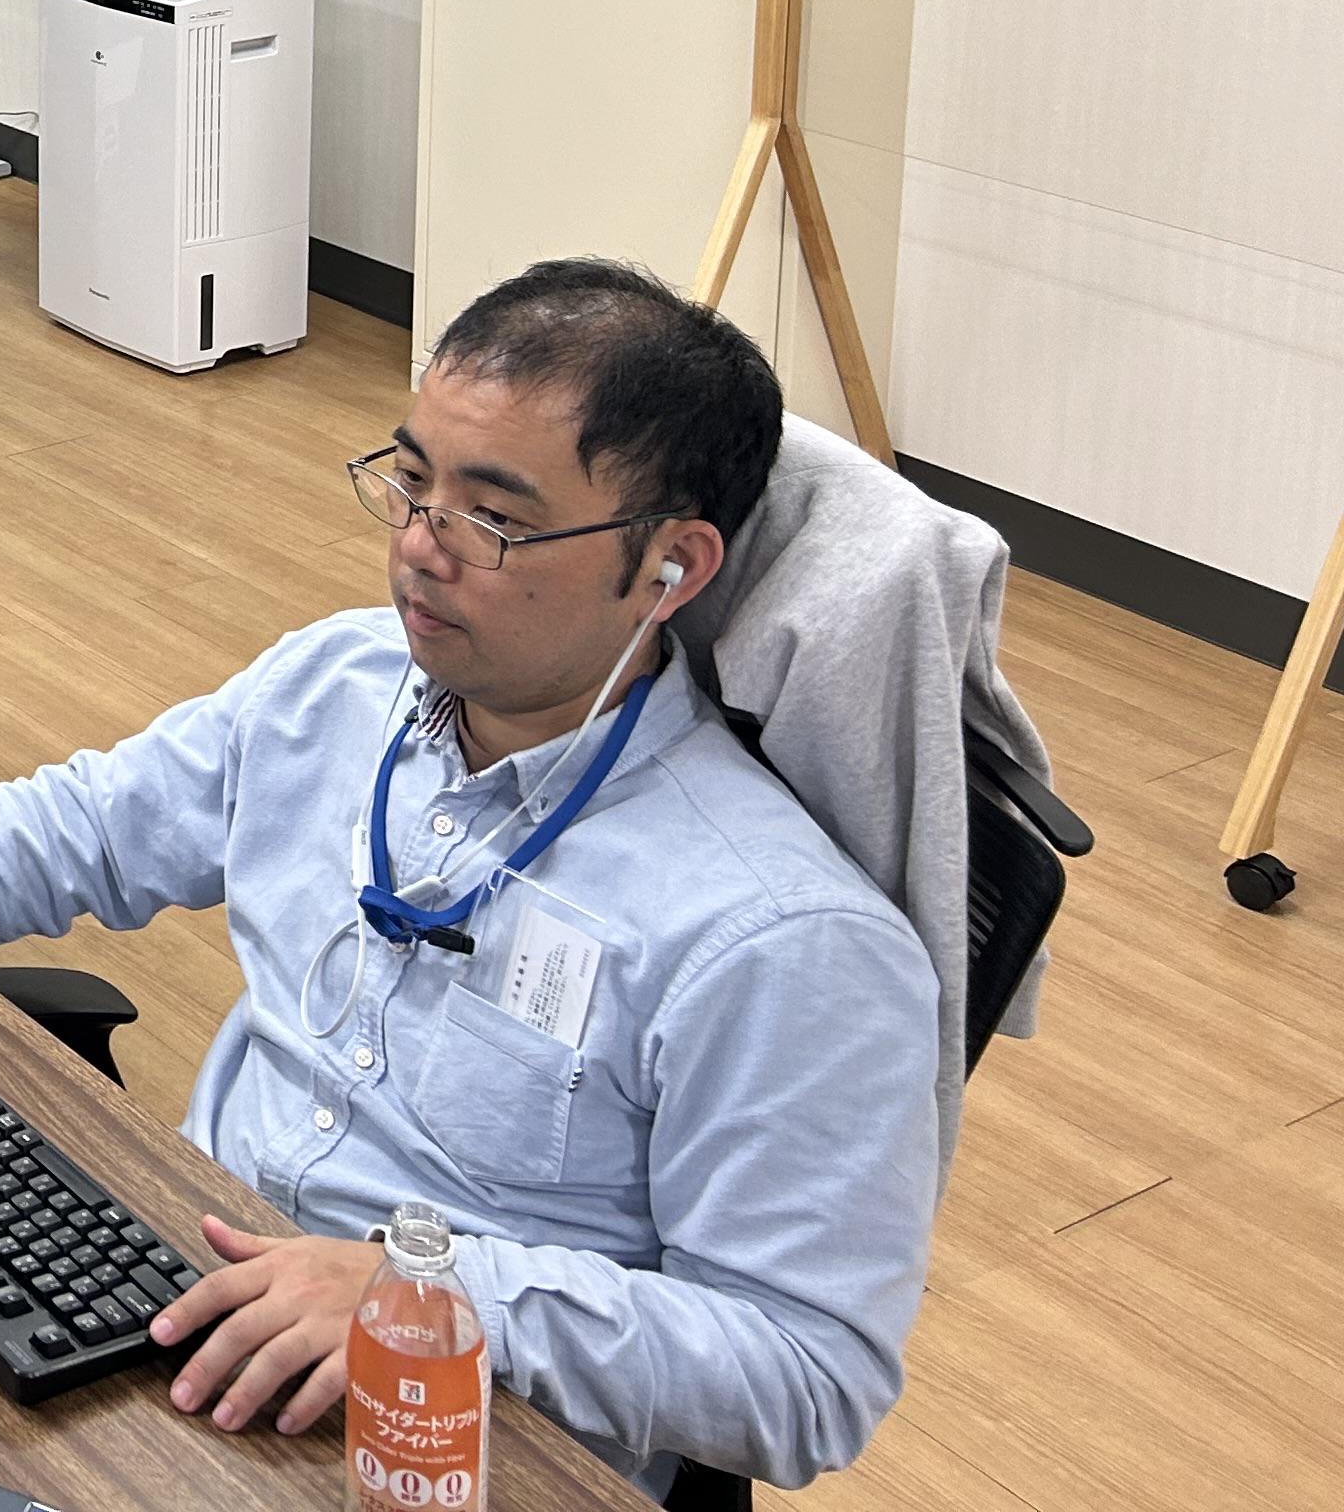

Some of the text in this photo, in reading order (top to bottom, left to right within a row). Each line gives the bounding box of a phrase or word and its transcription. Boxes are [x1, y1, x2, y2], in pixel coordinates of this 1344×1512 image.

[375, 1420, 453, 1449] ファイバー
